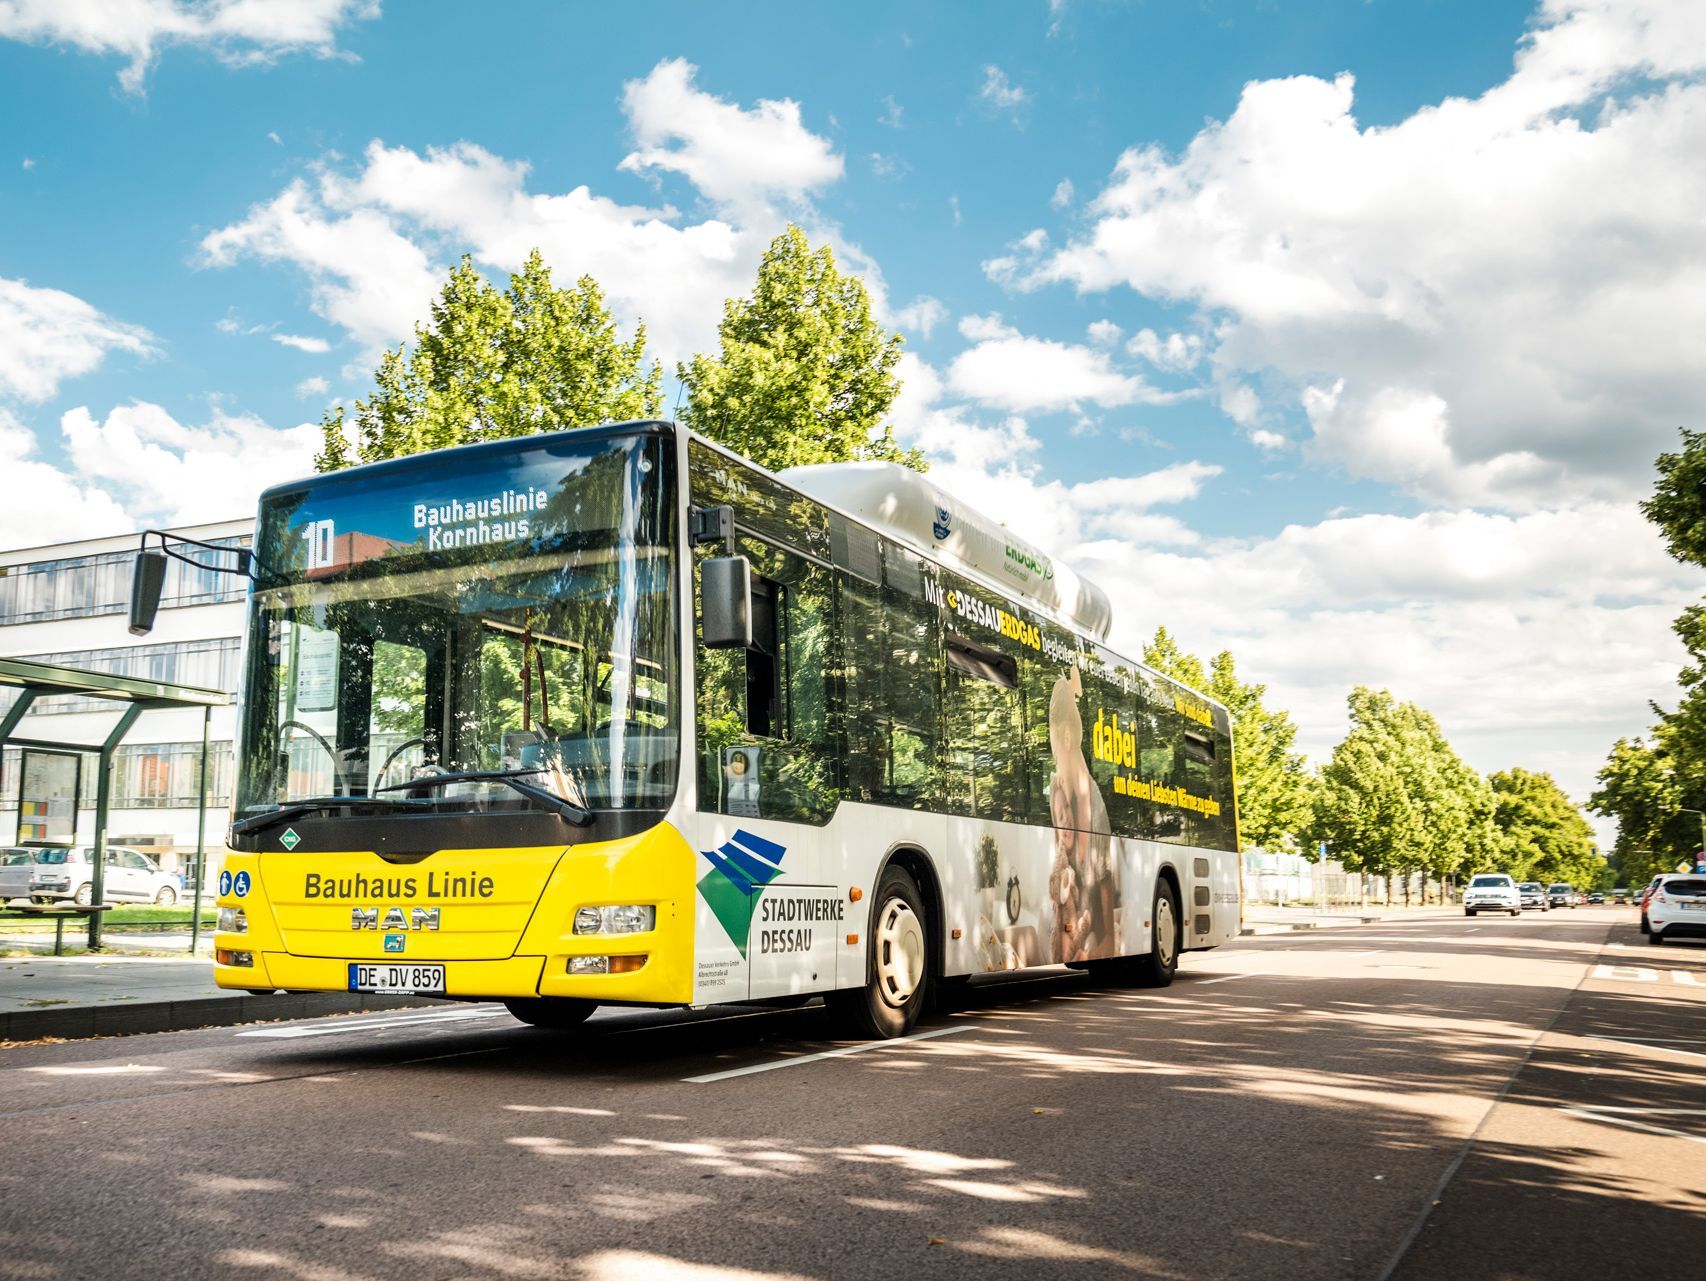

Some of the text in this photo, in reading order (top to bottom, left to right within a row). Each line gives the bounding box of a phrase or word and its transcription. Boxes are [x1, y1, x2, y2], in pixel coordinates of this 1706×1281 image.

[413, 487, 548, 528] Bauhauslinie
[302, 519, 335, 569] 10
[429, 519, 529, 550] Kornhaus
[924, 576, 946, 608] Mit
[1041, 631, 1077, 665] begleiten
[1093, 708, 1136, 768] dabei
[305, 872, 495, 898] Bauhaus Linie
[352, 907, 441, 930] MAN
[762, 898, 844, 921] STADTWERKE
[761, 929, 812, 954] DESSAU
[358, 967, 377, 986] DE
[389, 968, 408, 987] DV
[412, 968, 441, 988] 859
